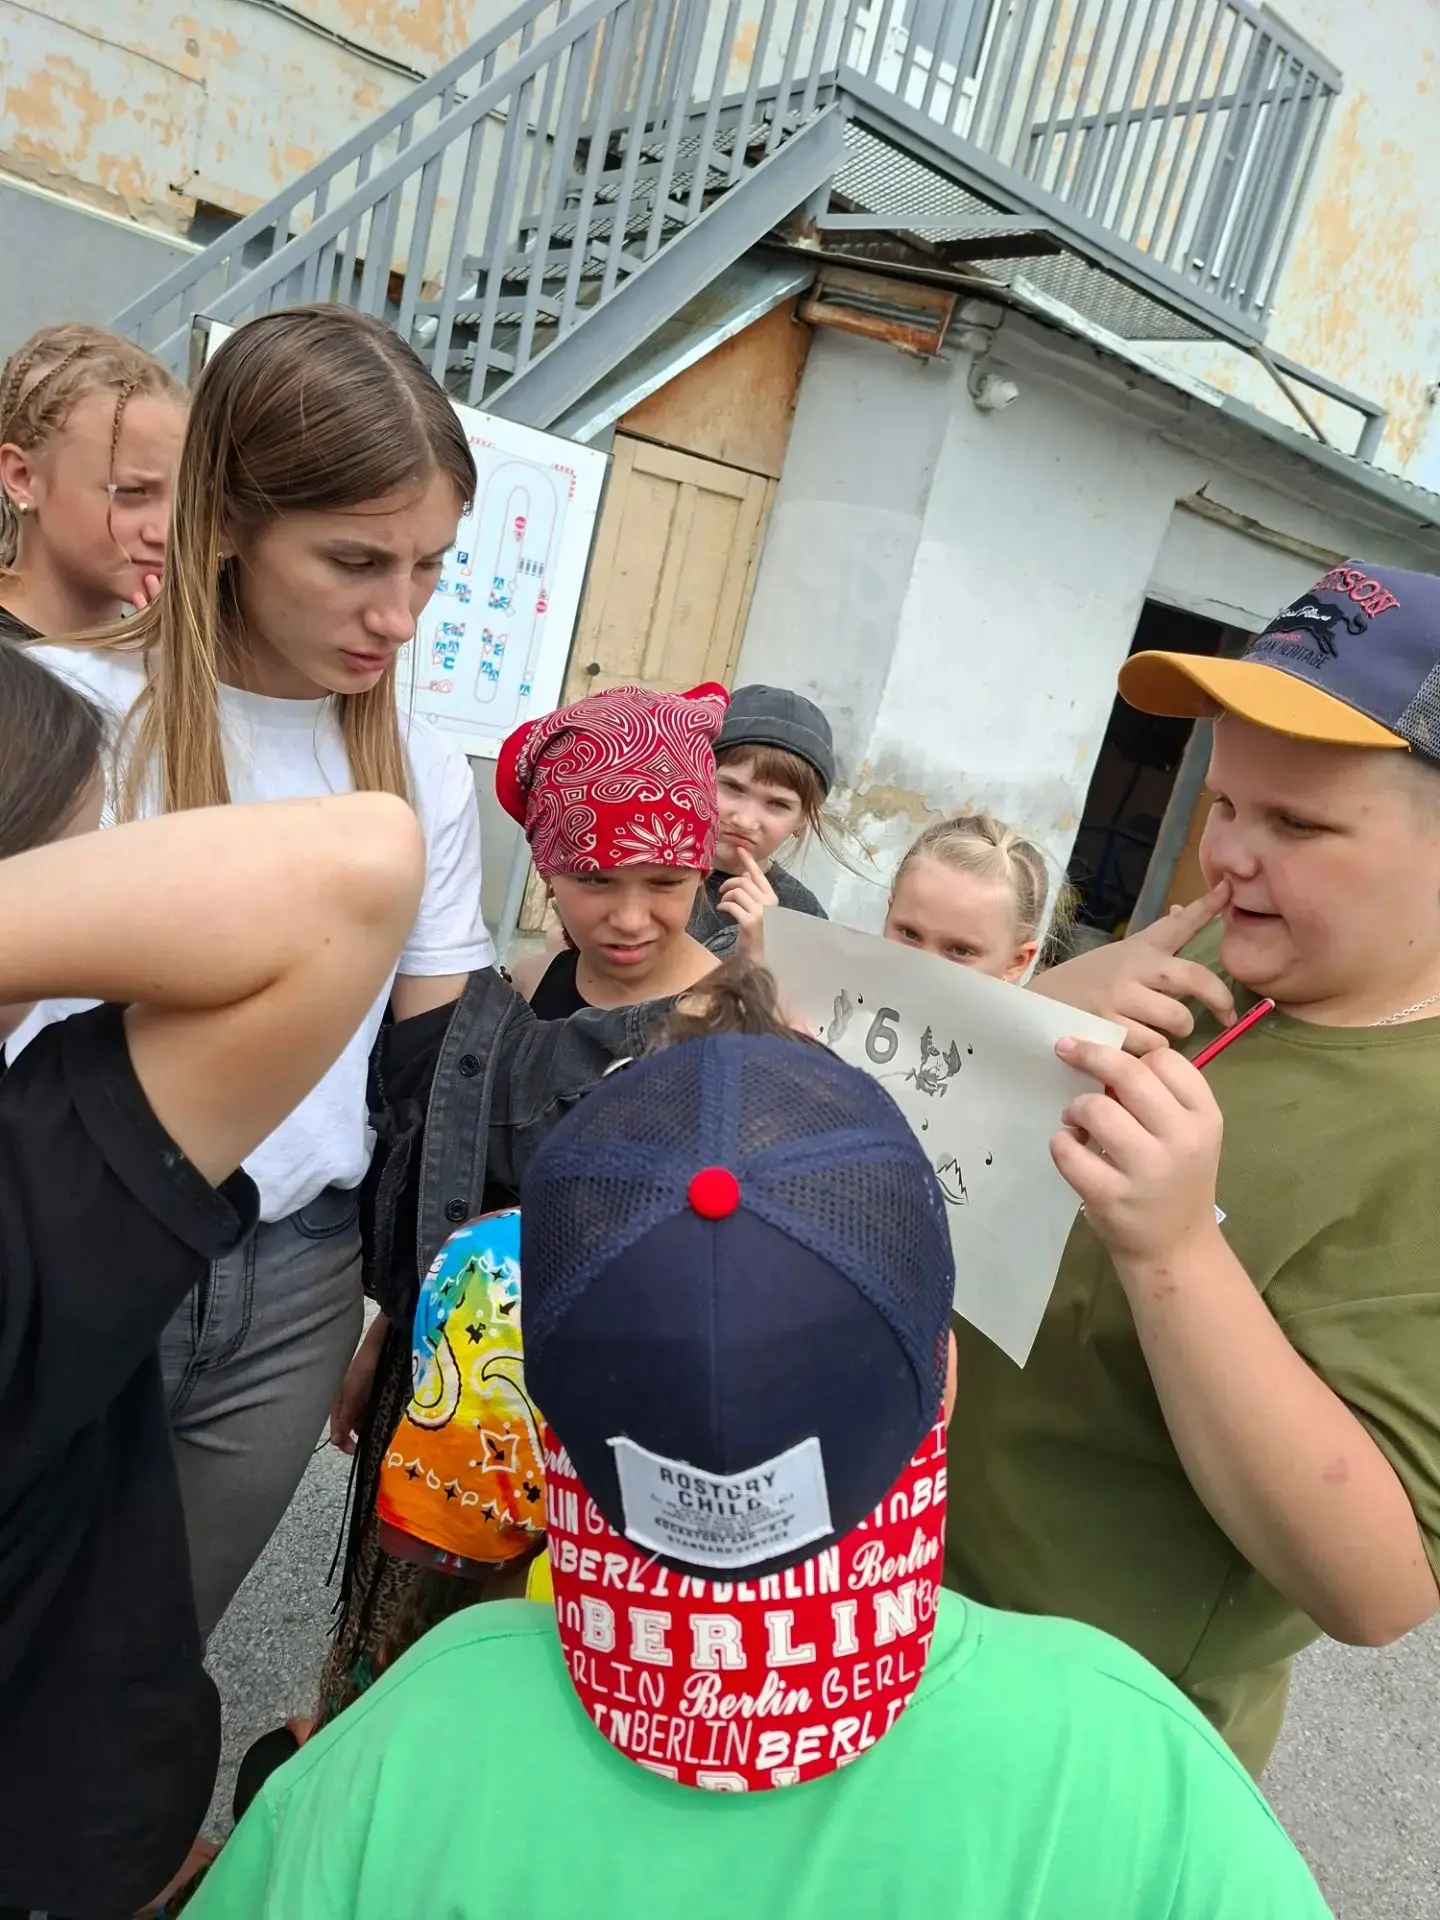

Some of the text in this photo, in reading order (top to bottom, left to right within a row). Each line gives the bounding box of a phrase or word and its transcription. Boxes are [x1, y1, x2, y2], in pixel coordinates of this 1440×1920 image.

[865, 1007, 900, 1064] 6
[548, 1484, 579, 1535] LIN
[678, 1491, 762, 1517] CHILD
[848, 1526, 940, 1590] Berlin
[581, 1579, 917, 1670] BERLIN
[679, 1670, 813, 1719] Berlin
[822, 1631, 933, 1709] BERLI
[631, 1708, 753, 1766] BERLIN
